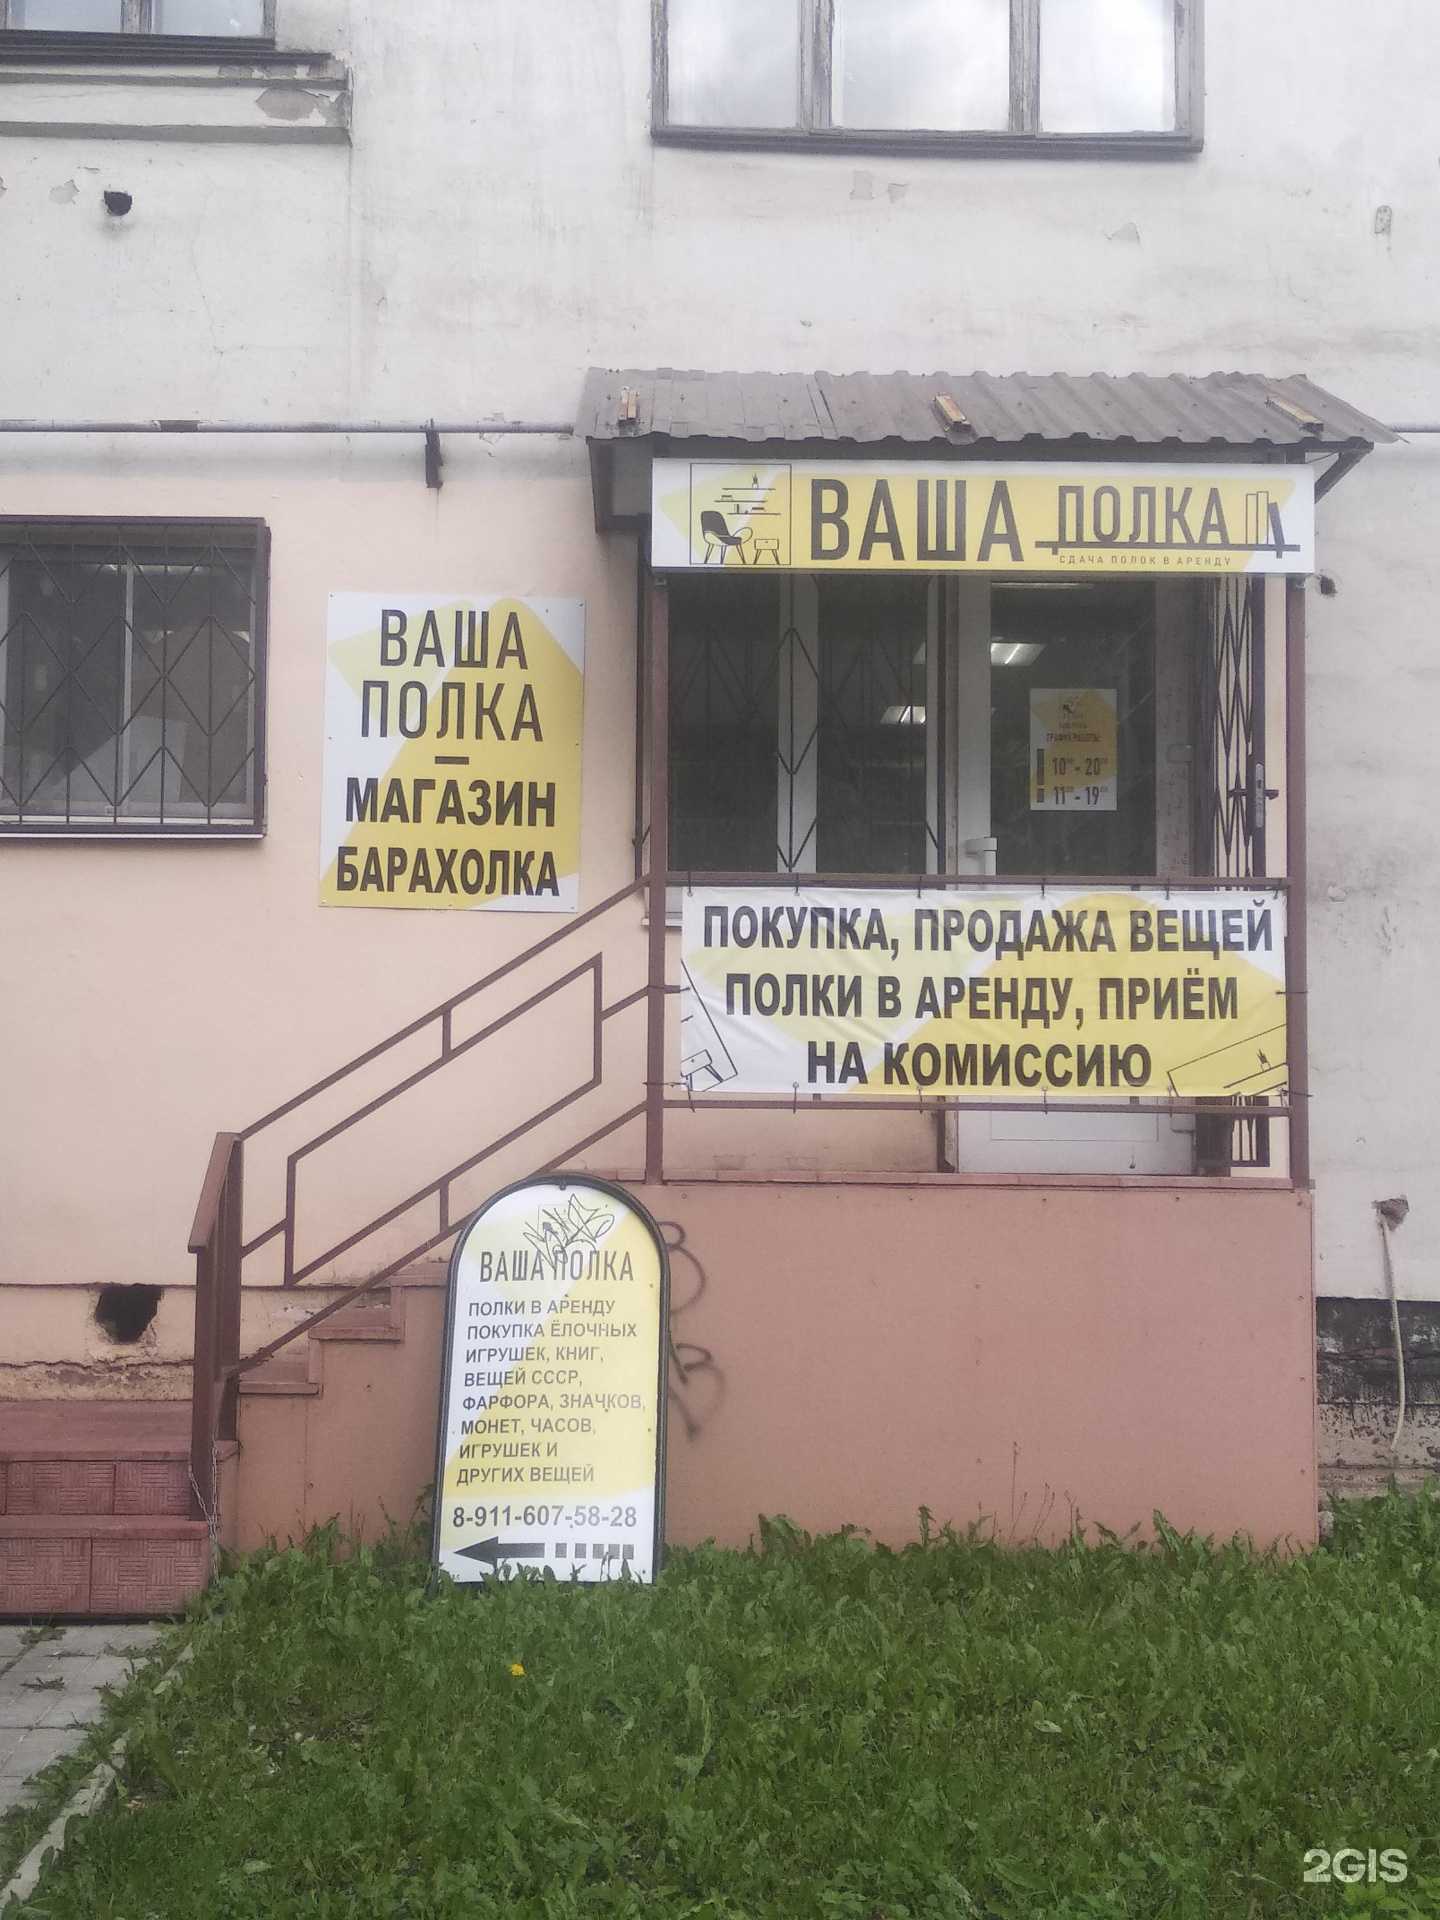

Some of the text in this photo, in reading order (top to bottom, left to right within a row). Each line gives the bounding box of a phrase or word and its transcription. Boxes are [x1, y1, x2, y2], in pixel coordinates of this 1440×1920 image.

[810, 478, 1232, 562] ВАША ПОЛКА
[1059, 554, 1232, 567] СДАЧА ПОЛОК В АРЕНДУ
[380, 609, 529, 670] ВАША
[361, 680, 544, 742] ПОЛКА
[346, 777, 556, 828] МАГАЗИН
[336, 846, 560, 897] БАРАХОЛКА
[703, 898, 1273, 961] ПОКУПКА, ПРОДАЖА ВЕЩЕЙ
[726, 967, 1239, 1030] ПОЛКИ В АРЕНДУ, ПРИЁМ
[807, 1040, 1152, 1088] НА КОМИССИЮ
[480, 1249, 634, 1282] ВАША ПОЛКА
[469, 1300, 615, 1319] ПОЛКИ В АРЕНДУ
[467, 1320, 637, 1340] ПОКУПКА ЁЛОЧНЫХ
[465, 1346, 604, 1363] ИГРУШЕК, КНИГ,
[464, 1368, 583, 1388] ВЕЩЕЙ СССР,
[462, 1393, 646, 1412] ФАРФОРА, ЗНАЧКОВ,
[461, 1418, 597, 1435] МОНЕТ, ЧАСОВ,
[459, 1442, 558, 1459] ИГРУШЕК И
[456, 1464, 594, 1486] ДРУГИХ ВЕЩЕЙ
[453, 1505, 637, 1527] 8-911-607-58-28
